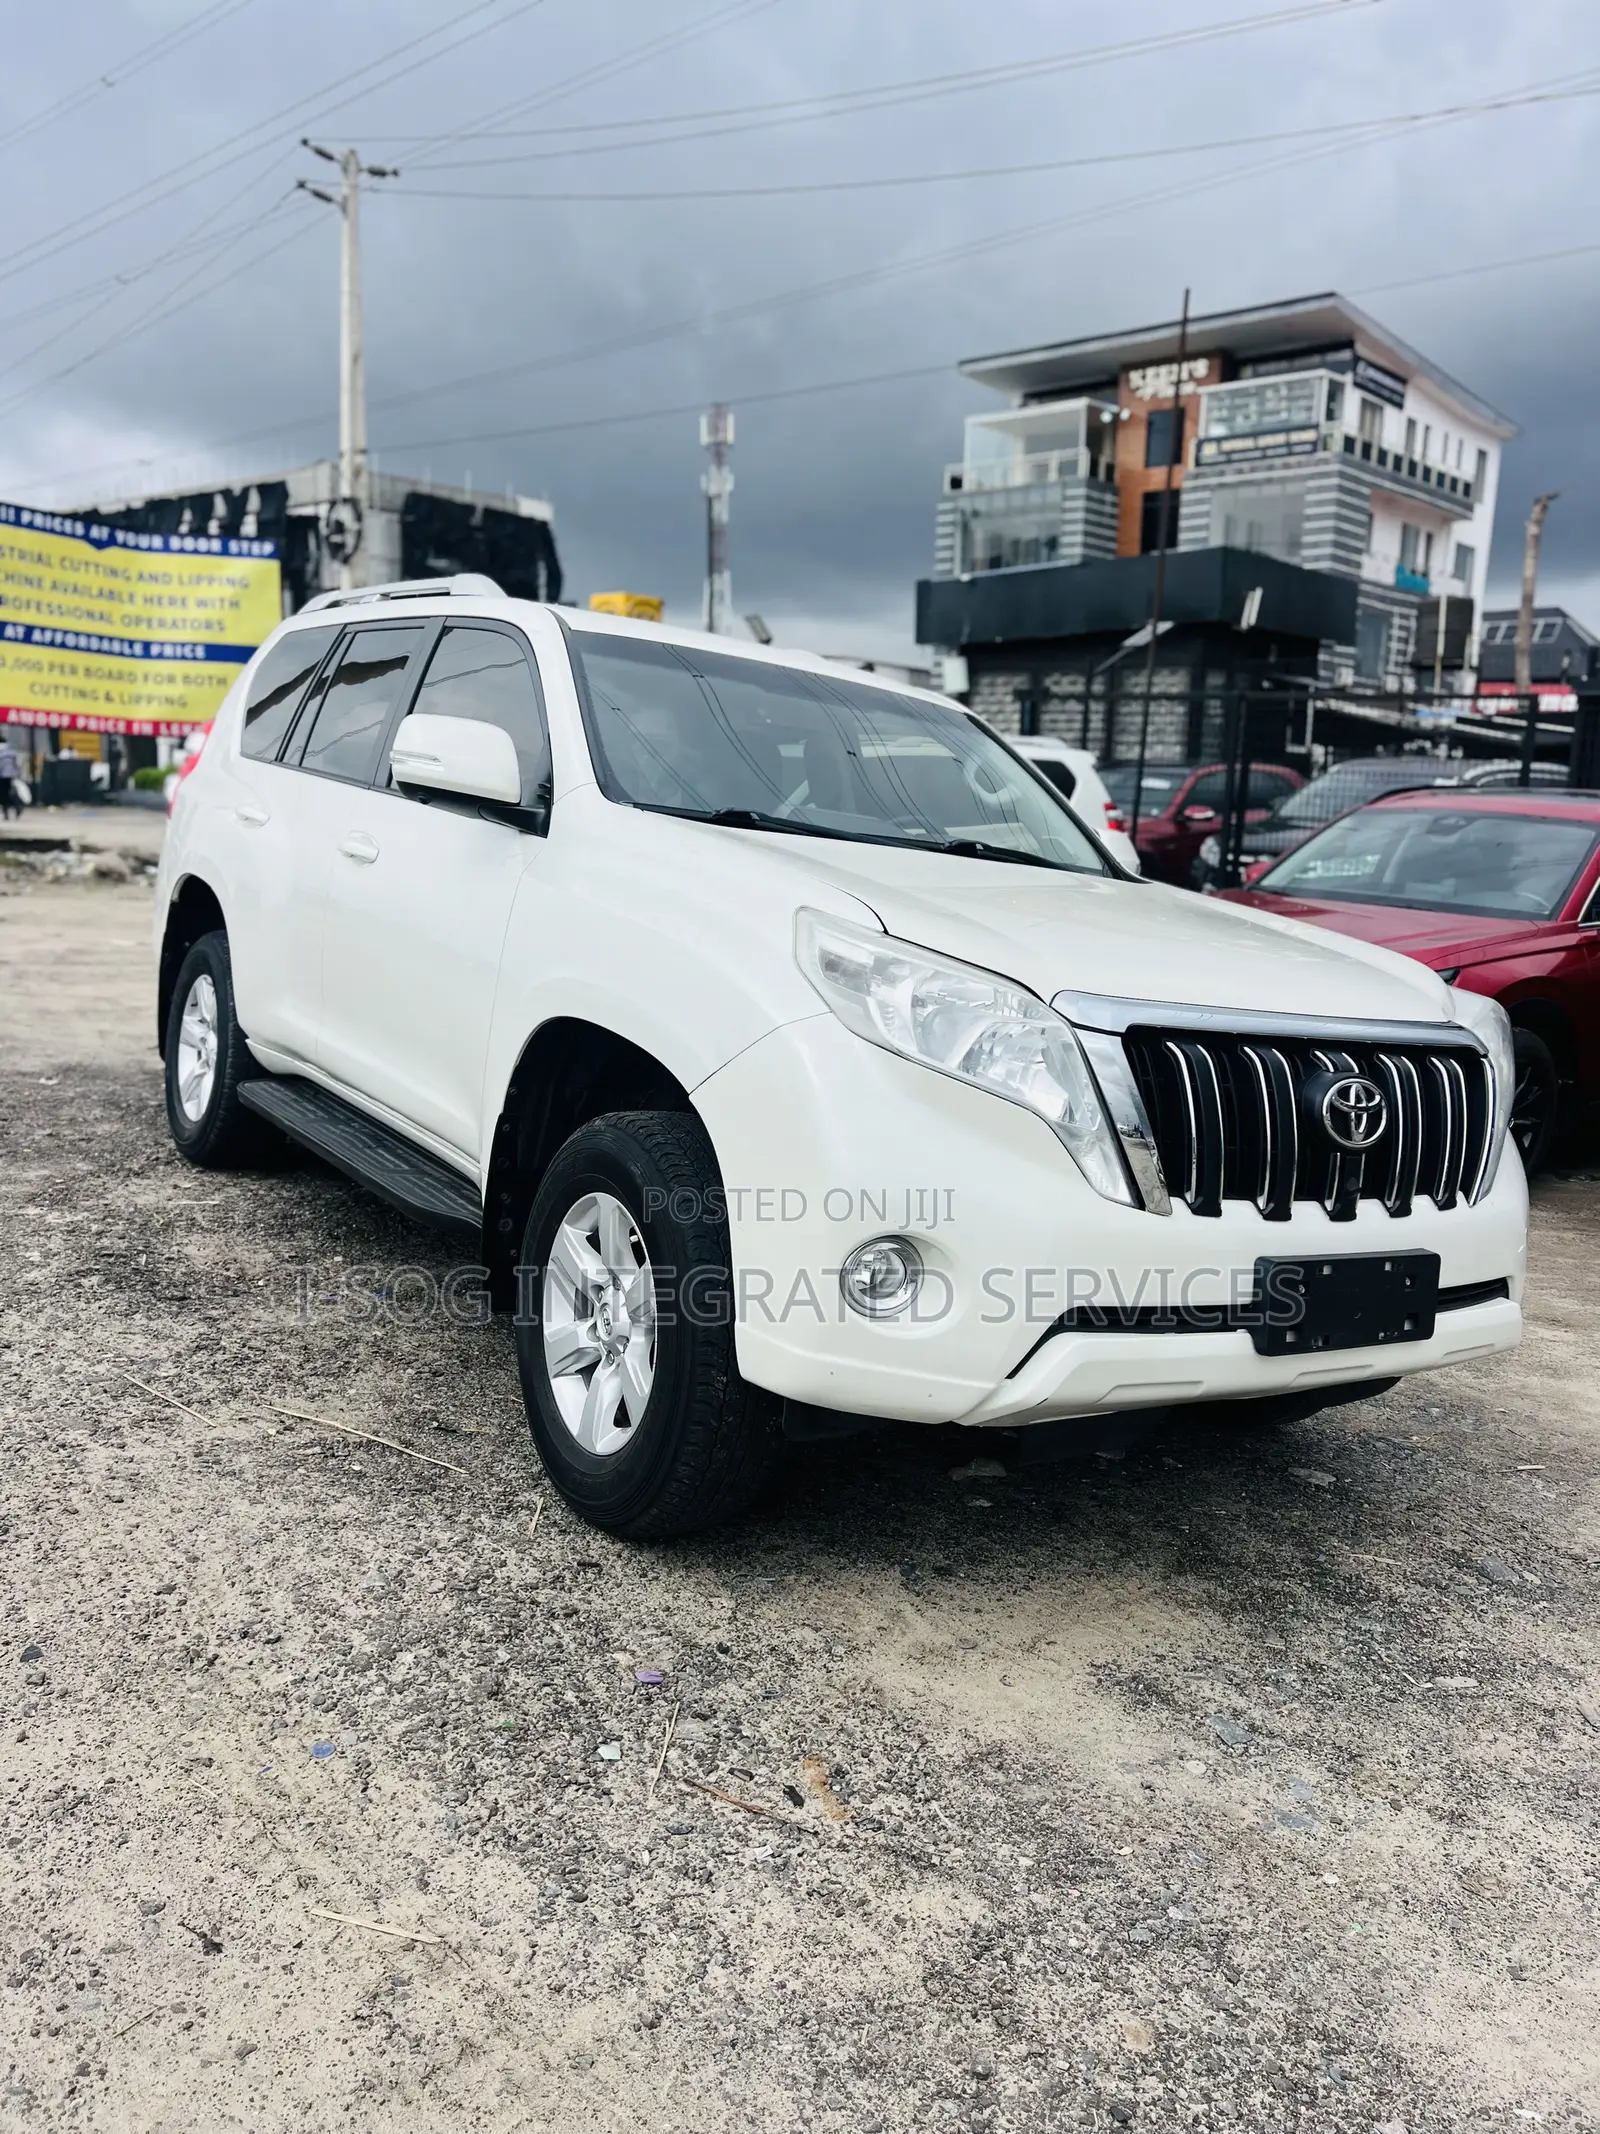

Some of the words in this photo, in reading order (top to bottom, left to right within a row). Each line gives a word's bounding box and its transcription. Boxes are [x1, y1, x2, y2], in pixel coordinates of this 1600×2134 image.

[21, 509, 85, 537] PRICES
[89, 523, 110, 541] AT
[115, 528, 164, 551] YOUR
[168, 534, 222, 554] DOOR
[228, 539, 275, 556] STEP
[59, 555, 131, 582] CUTTING
[137, 570, 172, 585] AND
[178, 572, 249, 589] LIPPING
[50, 579, 136, 606] AVAILABLE
[143, 594, 188, 609] HERE
[195, 596, 240, 610] WITH
[120, 613, 225, 633] OPERATORS
[4, 623, 25, 641] AT
[31, 627, 143, 657] AFFORDABLE
[149, 642, 206, 659] PRICE
[47, 661, 78, 676] PER
[83, 665, 137, 684] BOARD
[143, 671, 177, 685] FOR
[182, 672, 228, 688] BOTH
[28, 680, 100, 702] CUTTING
[103, 690, 115, 704] &
[118, 691, 188, 709] LIPPING
[76, 715, 127, 734] PRICE
[131, 719, 154, 736] IN
